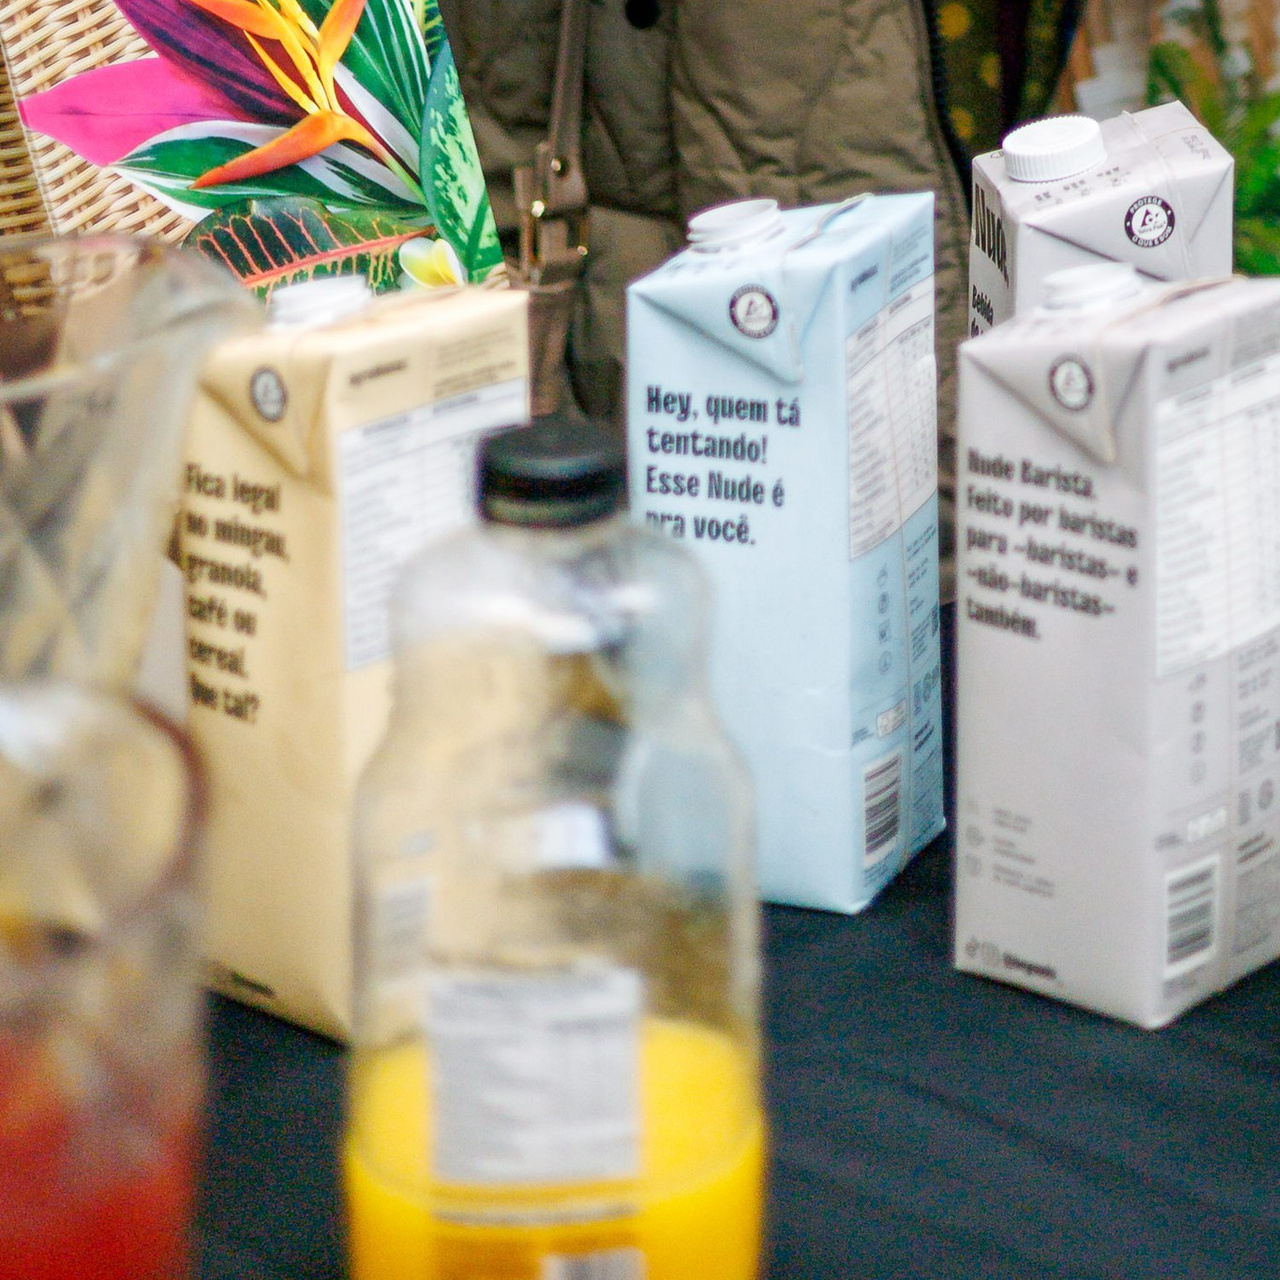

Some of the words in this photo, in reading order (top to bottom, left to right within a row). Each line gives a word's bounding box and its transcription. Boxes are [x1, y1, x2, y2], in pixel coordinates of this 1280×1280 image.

[1130, 198, 1162, 214] PROTEGE
[972, 284, 994, 328] Bebida
[646, 384, 698, 422] Hey,
[706, 394, 768, 425] quem
[776, 396, 801, 427] tá
[646, 426, 768, 464] tentando!
[185, 463, 226, 499] Fica
[233, 473, 281, 515] legal
[646, 464, 700, 497] Esse
[708, 470, 765, 505] Nude
[772, 477, 785, 507] é
[968, 446, 1014, 482] Nude
[1020, 457, 1097, 501] Barista.
[693, 513, 756, 545] você.
[967, 484, 1013, 518] Feito
[1019, 500, 1053, 526] por
[1059, 504, 1138, 549] baristas
[967, 526, 1007, 555] para
[1126, 566, 1138, 587] e
[967, 596, 1040, 639] também.
